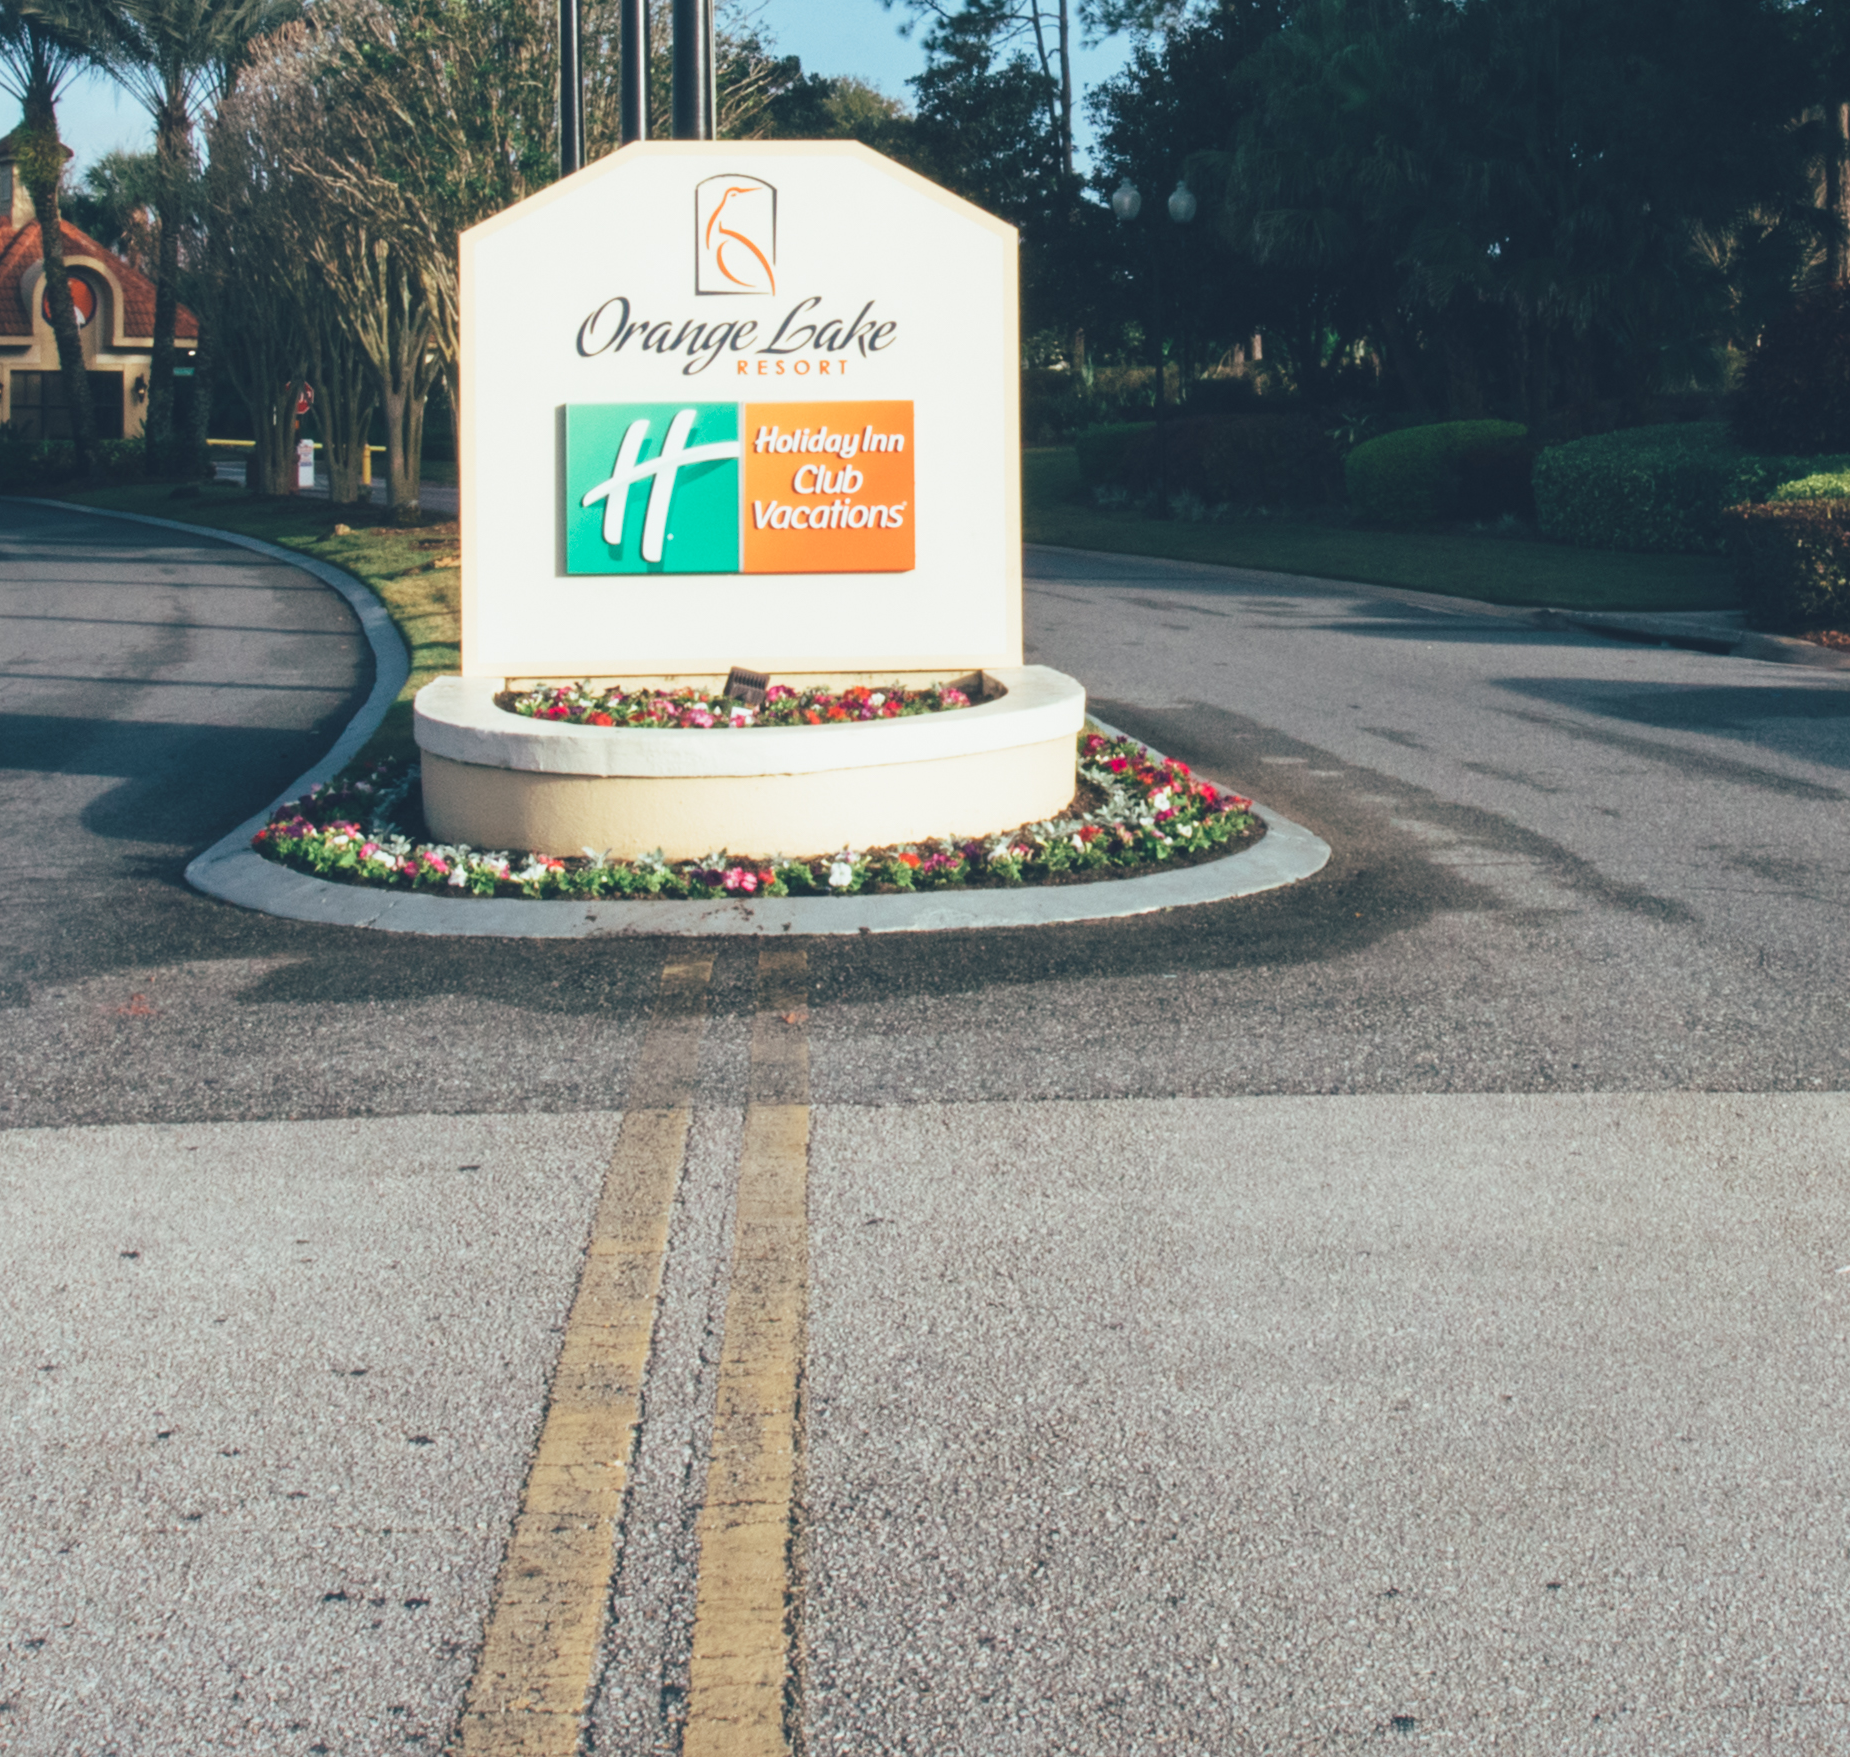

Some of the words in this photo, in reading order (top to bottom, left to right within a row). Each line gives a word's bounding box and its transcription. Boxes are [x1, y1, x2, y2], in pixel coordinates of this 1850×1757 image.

[576, 296, 758, 375] Orange
[754, 296, 897, 358] Lake
[737, 359, 848, 375] RESORT
[754, 425, 860, 459] Holiday
[861, 424, 905, 452] Inn
[792, 463, 864, 494] Club
[753, 497, 906, 529] Vacations
